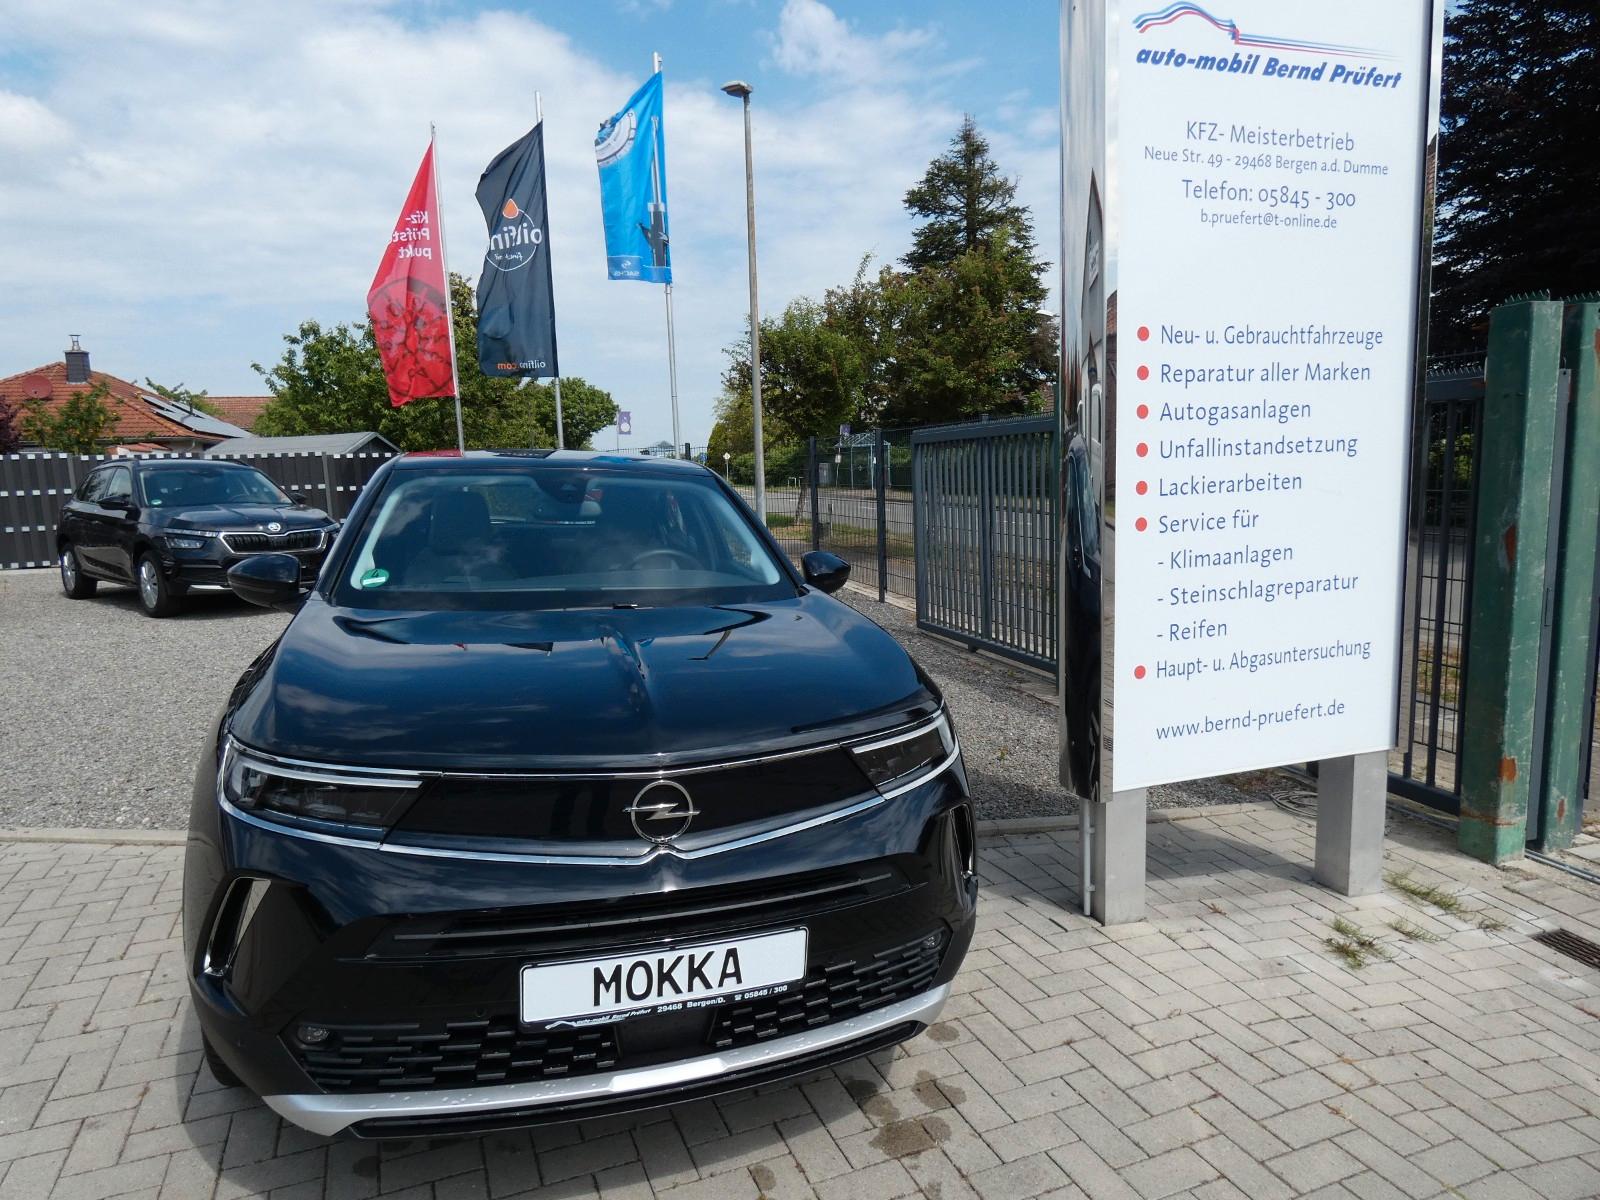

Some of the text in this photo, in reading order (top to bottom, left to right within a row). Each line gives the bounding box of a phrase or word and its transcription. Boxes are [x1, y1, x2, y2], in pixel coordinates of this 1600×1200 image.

[1135, 48, 1403, 89] auto-mobil Bernd Prüfert
[1186, 120, 1355, 152] KFZ- Meisterbetrieb
[1144, 145, 1178, 162] Neue
[1182, 148, 1204, 164] Str.
[1207, 153, 1223, 169] 49
[1235, 154, 1272, 171] 29468
[1275, 156, 1318, 174] Bergen
[1321, 158, 1341, 173] a.d.
[1343, 160, 1389, 176] Dumme
[1181, 178, 1253, 202] Telefon:
[1258, 185, 1310, 210] 05845
[1326, 191, 1356, 211] 300
[1200, 208, 1337, 229] b.pruefert@t-online.de
[1161, 323, 1384, 351] Neu- u. Gebrauchtfahrzeuge
[1160, 361, 1371, 390] Reparatur aller Marken
[1159, 398, 1312, 427] Autogasanlagen
[1160, 434, 1359, 459] Unfallinstandsetzung
[1159, 472, 1302, 497] Lackierarbeiten
[1158, 508, 1260, 534] Service für
[1169, 544, 1294, 570] Klimaanlagen
[1169, 574, 1359, 606] Steinschlagreparatur
[1169, 618, 1228, 642] Reifen
[1156, 639, 1372, 681] Haupt- u. Abgasuntersuchung
[1155, 698, 1346, 740] www.bernd-pruefert.de
[593, 947, 743, 1007] MOKKA
[656, 1002, 683, 1013] 29468
[744, 989, 768, 1000] 05845
[773, 984, 788, 994] 300
